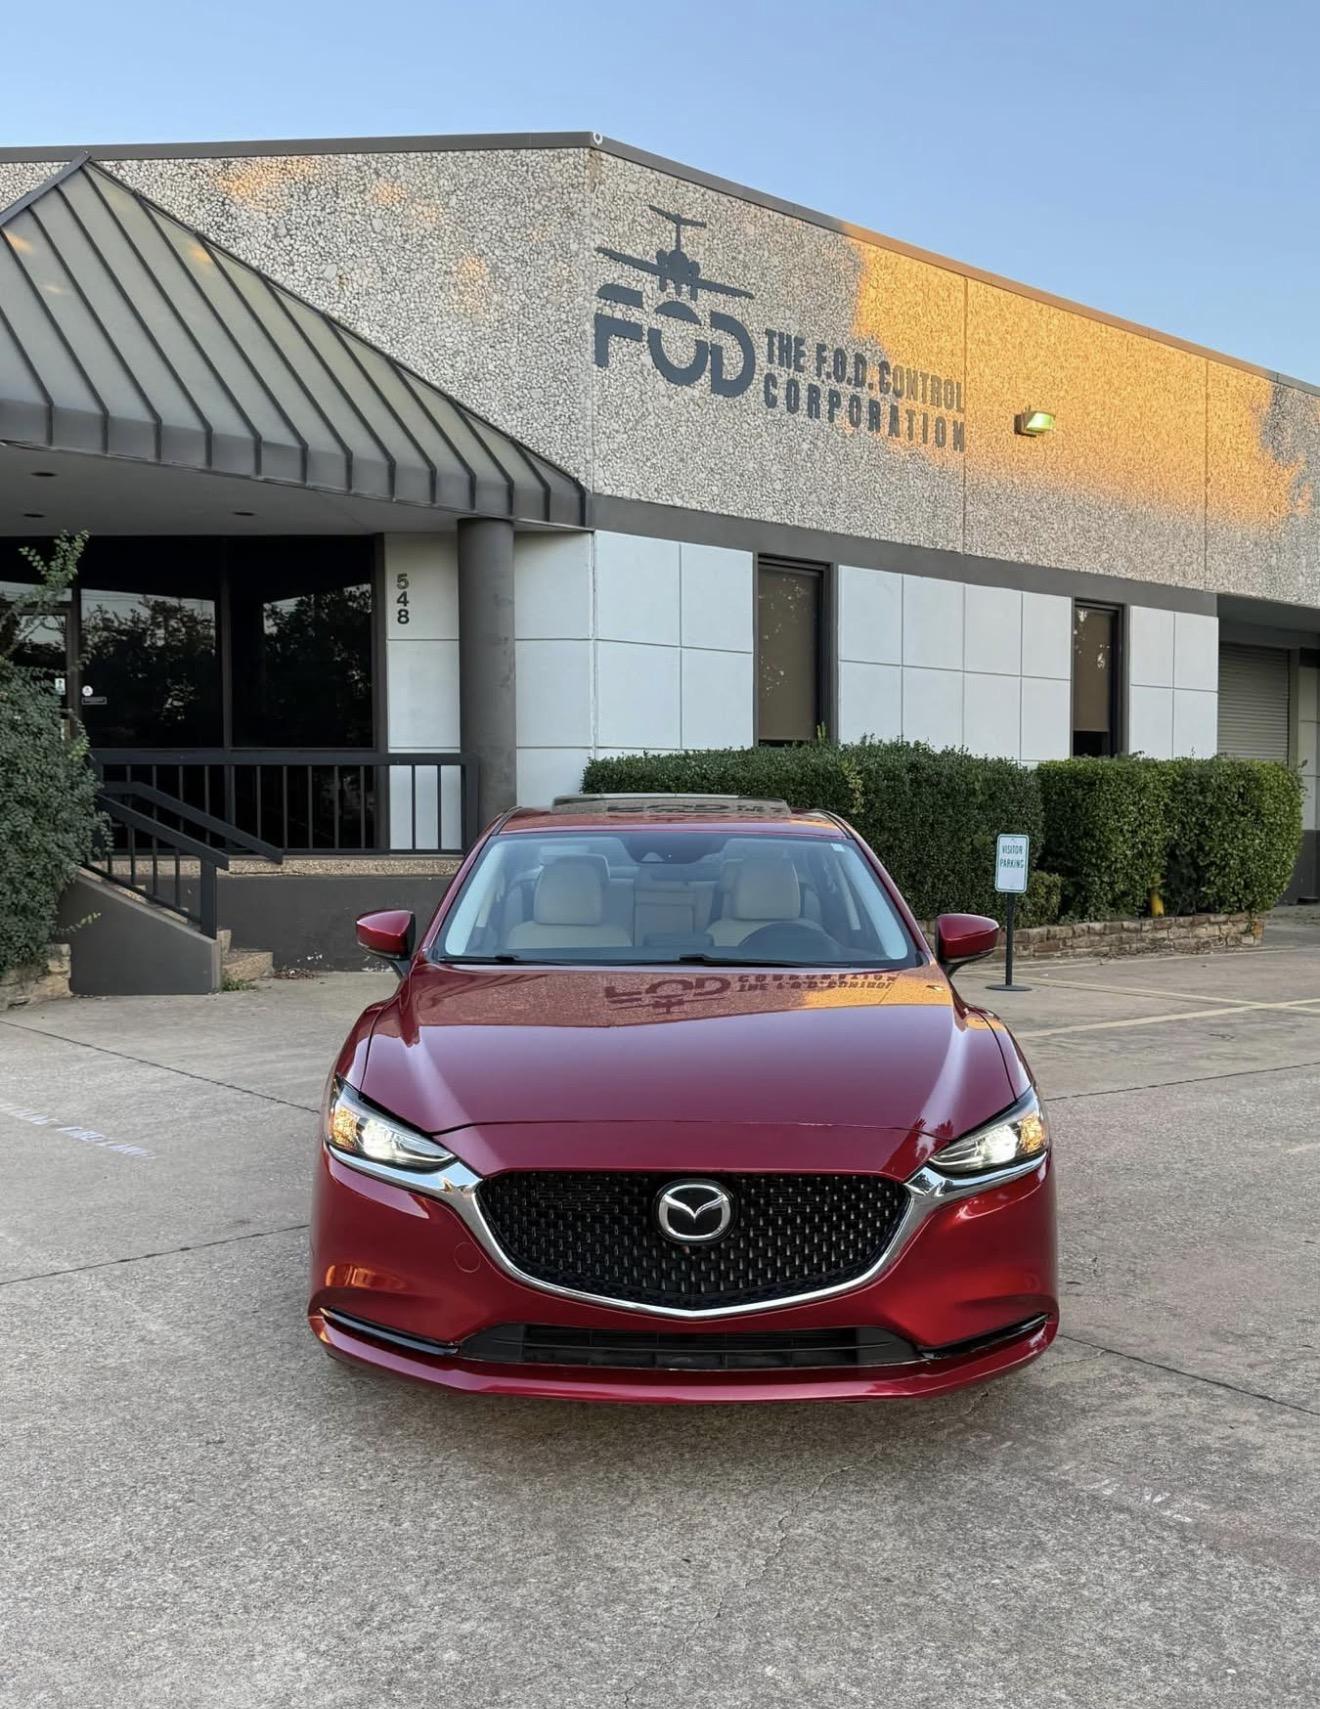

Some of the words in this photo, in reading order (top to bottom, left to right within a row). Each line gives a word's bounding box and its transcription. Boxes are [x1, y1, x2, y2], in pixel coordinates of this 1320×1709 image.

[594, 283, 756, 397] FOD
[765, 328, 806, 373] THE
[815, 343, 874, 390] F.O.D.
[878, 361, 964, 413] CONTROL
[764, 372, 965, 452] CORPORATION
[396, 573, 410, 624] 548
[1000, 859, 1024, 868] PARKING
[1002, 845, 1023, 854] VISITOR
